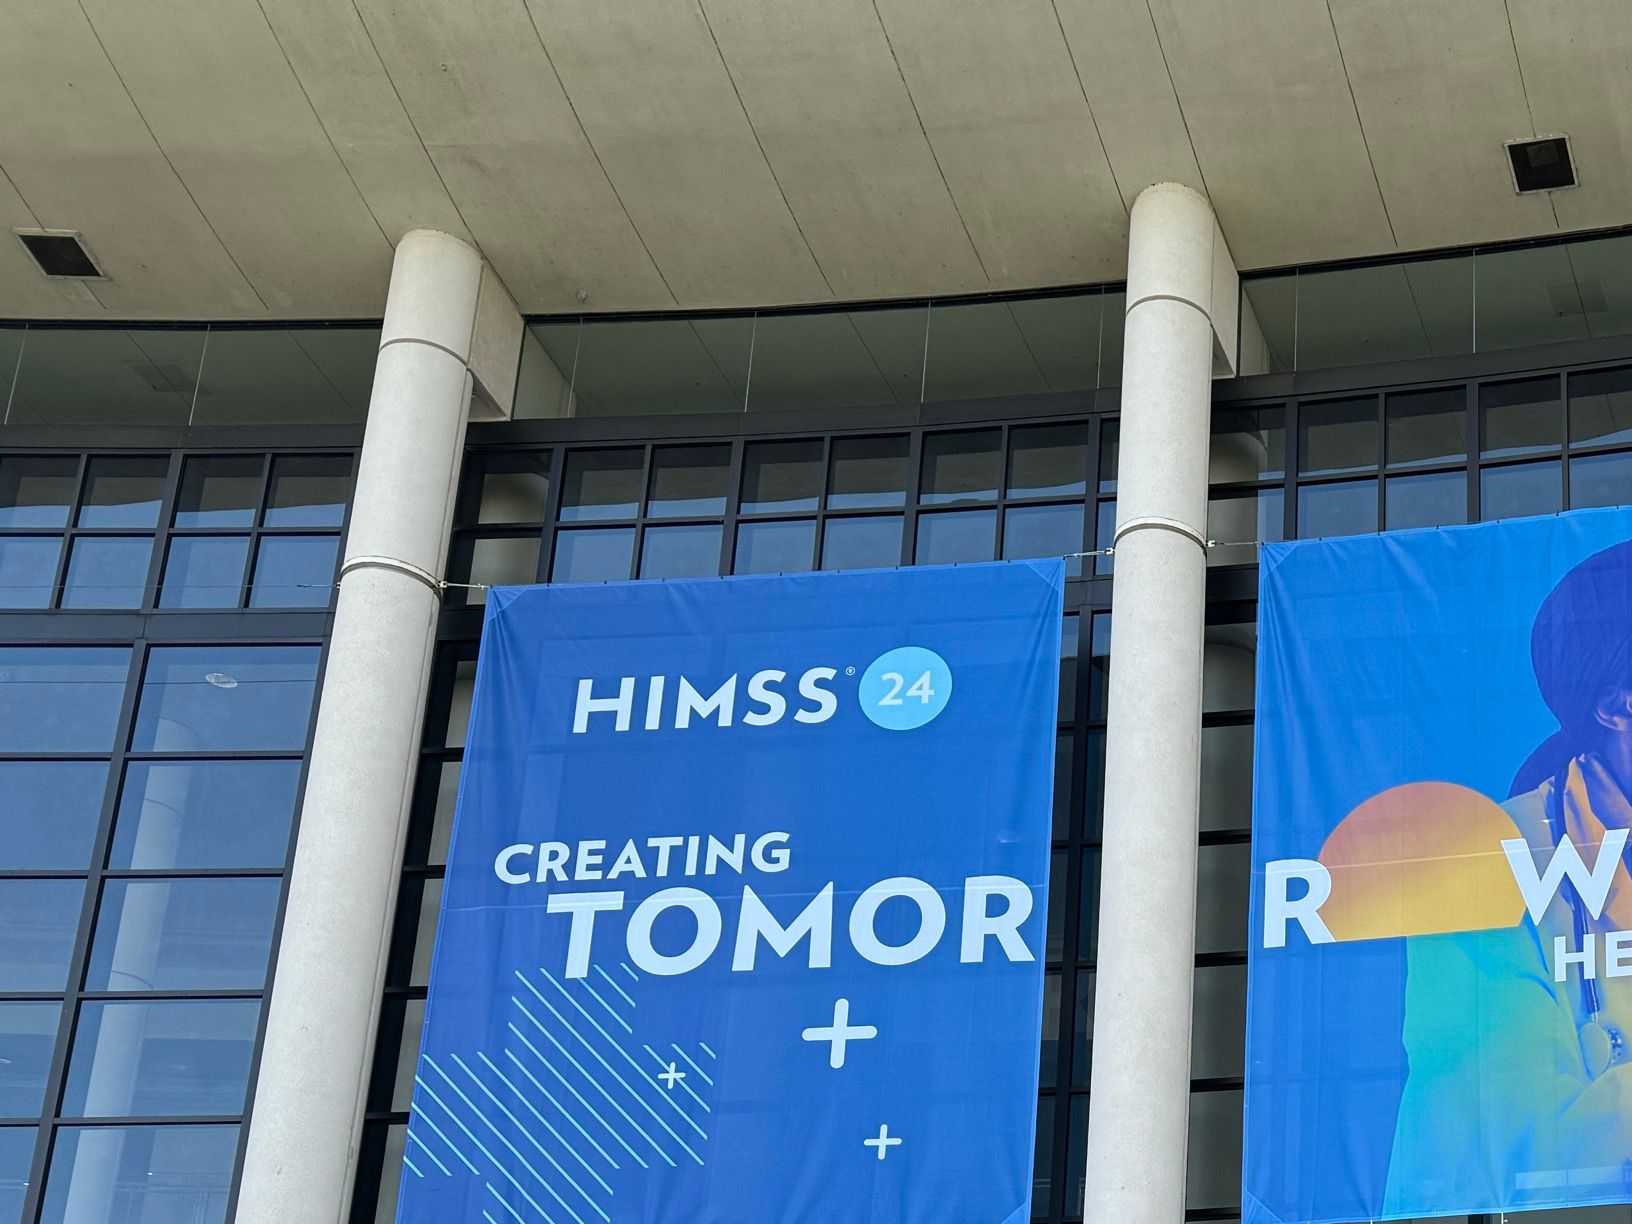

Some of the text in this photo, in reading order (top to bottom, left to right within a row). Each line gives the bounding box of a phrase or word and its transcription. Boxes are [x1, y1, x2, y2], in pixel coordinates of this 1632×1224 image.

[878, 670, 935, 708] 24
[493, 831, 792, 885] CREATING
[546, 875, 1036, 979] TOMOR
[1263, 859, 1336, 948] R
